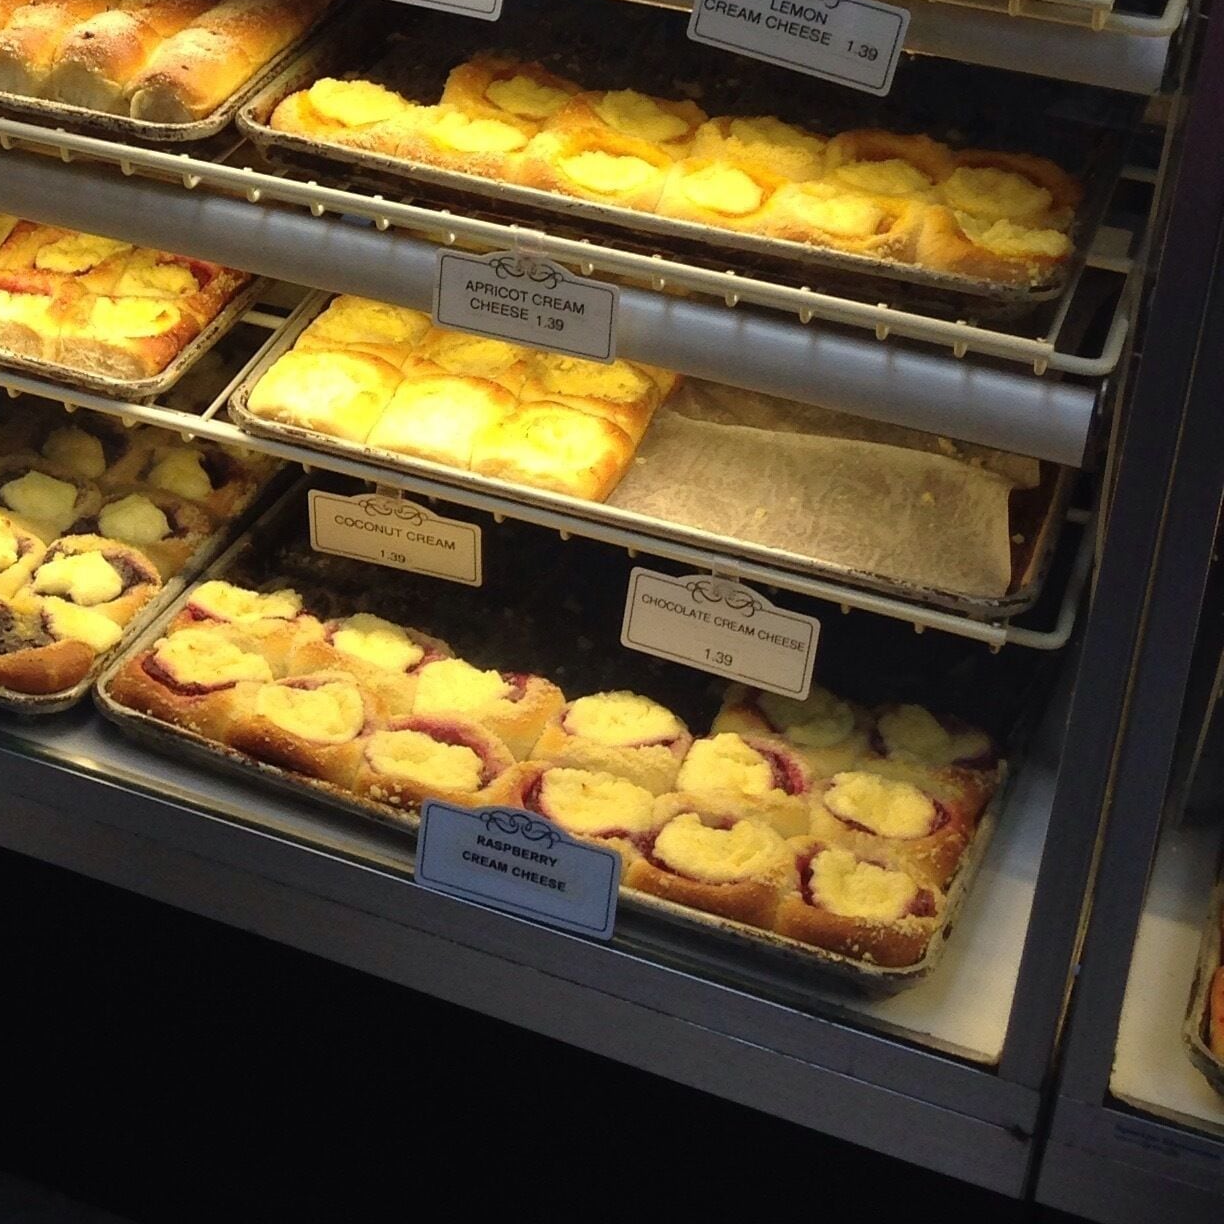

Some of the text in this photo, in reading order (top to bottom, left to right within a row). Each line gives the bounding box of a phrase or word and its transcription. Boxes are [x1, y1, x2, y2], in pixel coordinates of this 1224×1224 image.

[765, 15, 833, 46] CHEESE
[846, 40, 879, 62] 1.39
[465, 279, 585, 316] APRICOT CREAM
[469, 296, 565, 332] CHEESE 1.39
[334, 514, 456, 551] COCONUT CREAM
[379, 549, 406, 564] 1.39
[641, 593, 806, 652] CHOCOLATE CREAM CHEESE
[704, 648, 733, 666] 1.39
[476, 834, 559, 868] RASPBERRY
[461, 850, 567, 893] CREAM CHEESE
